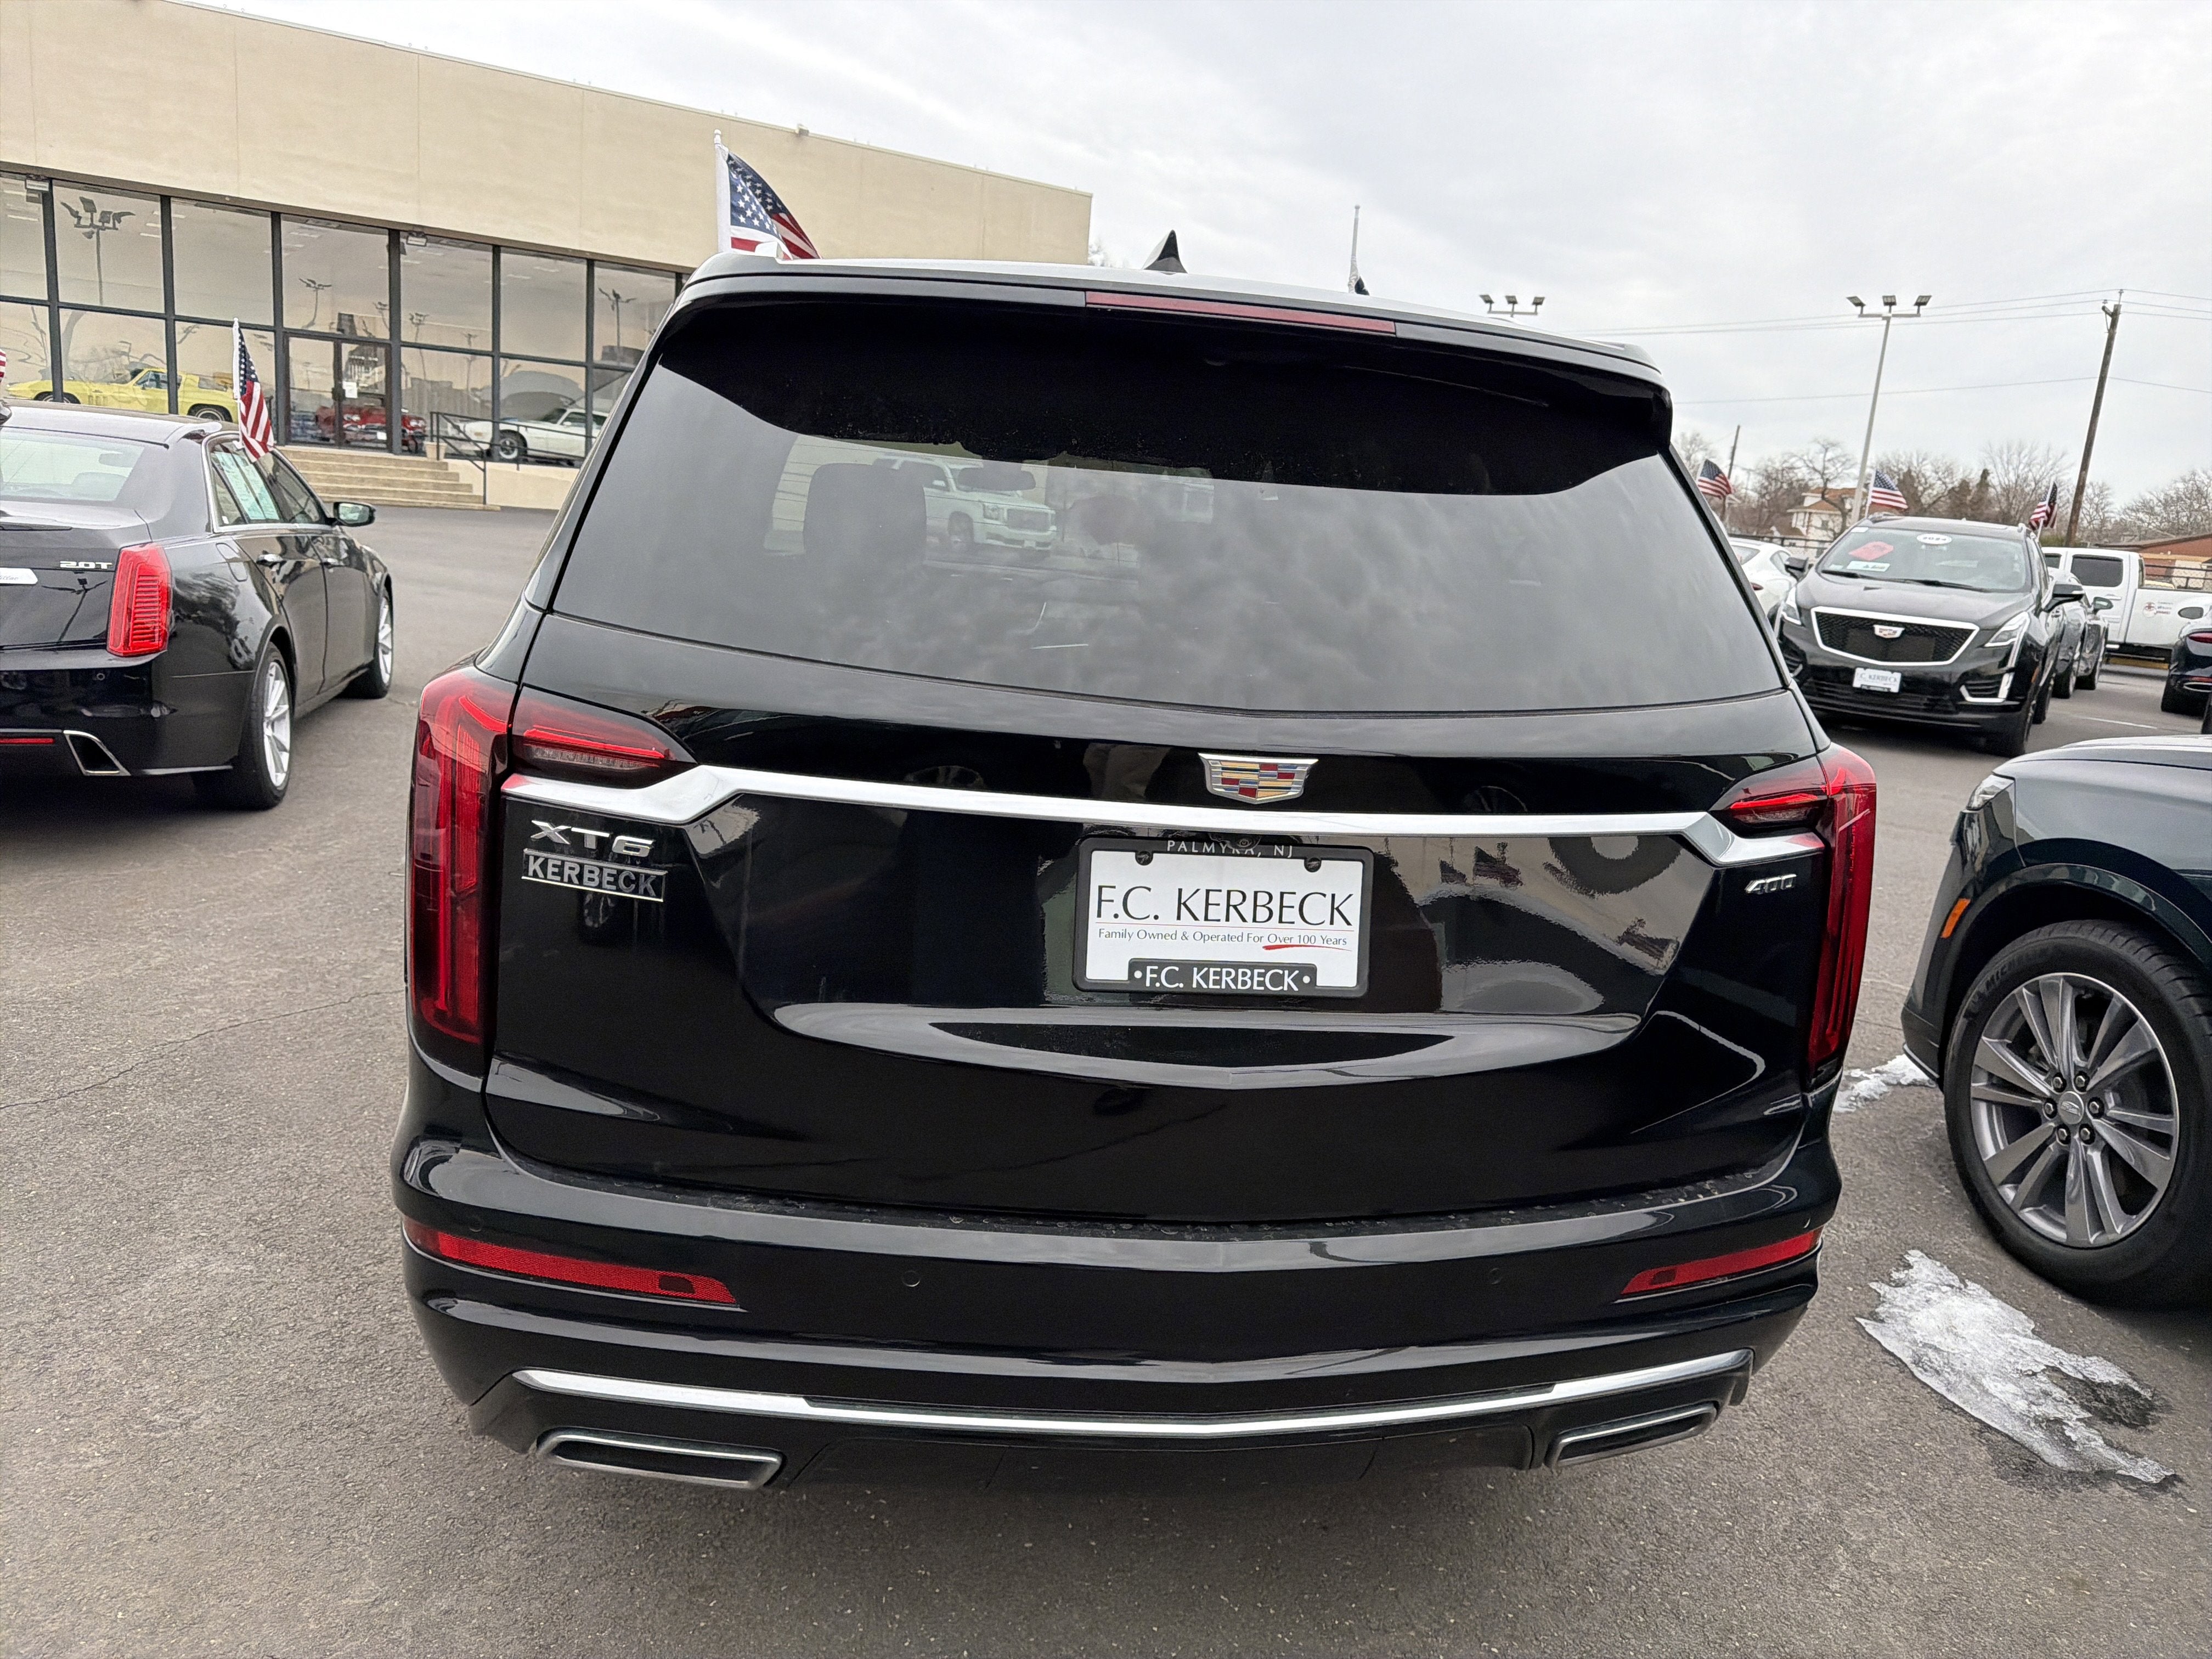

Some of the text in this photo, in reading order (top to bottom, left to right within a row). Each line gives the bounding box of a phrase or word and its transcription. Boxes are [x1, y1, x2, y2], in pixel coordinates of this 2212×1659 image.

[531, 820, 655, 857] XT6
[1273, 845, 1293, 858] NJ
[528, 855, 656, 896] KERBECK
[1745, 873, 1797, 895] 400
[1096, 885, 1354, 927] F.C. KERBECK
[1098, 928, 1347, 946] Family Owned & Operated For Over 100 Years
[1146, 966, 1300, 992] F.C. KERBECK
